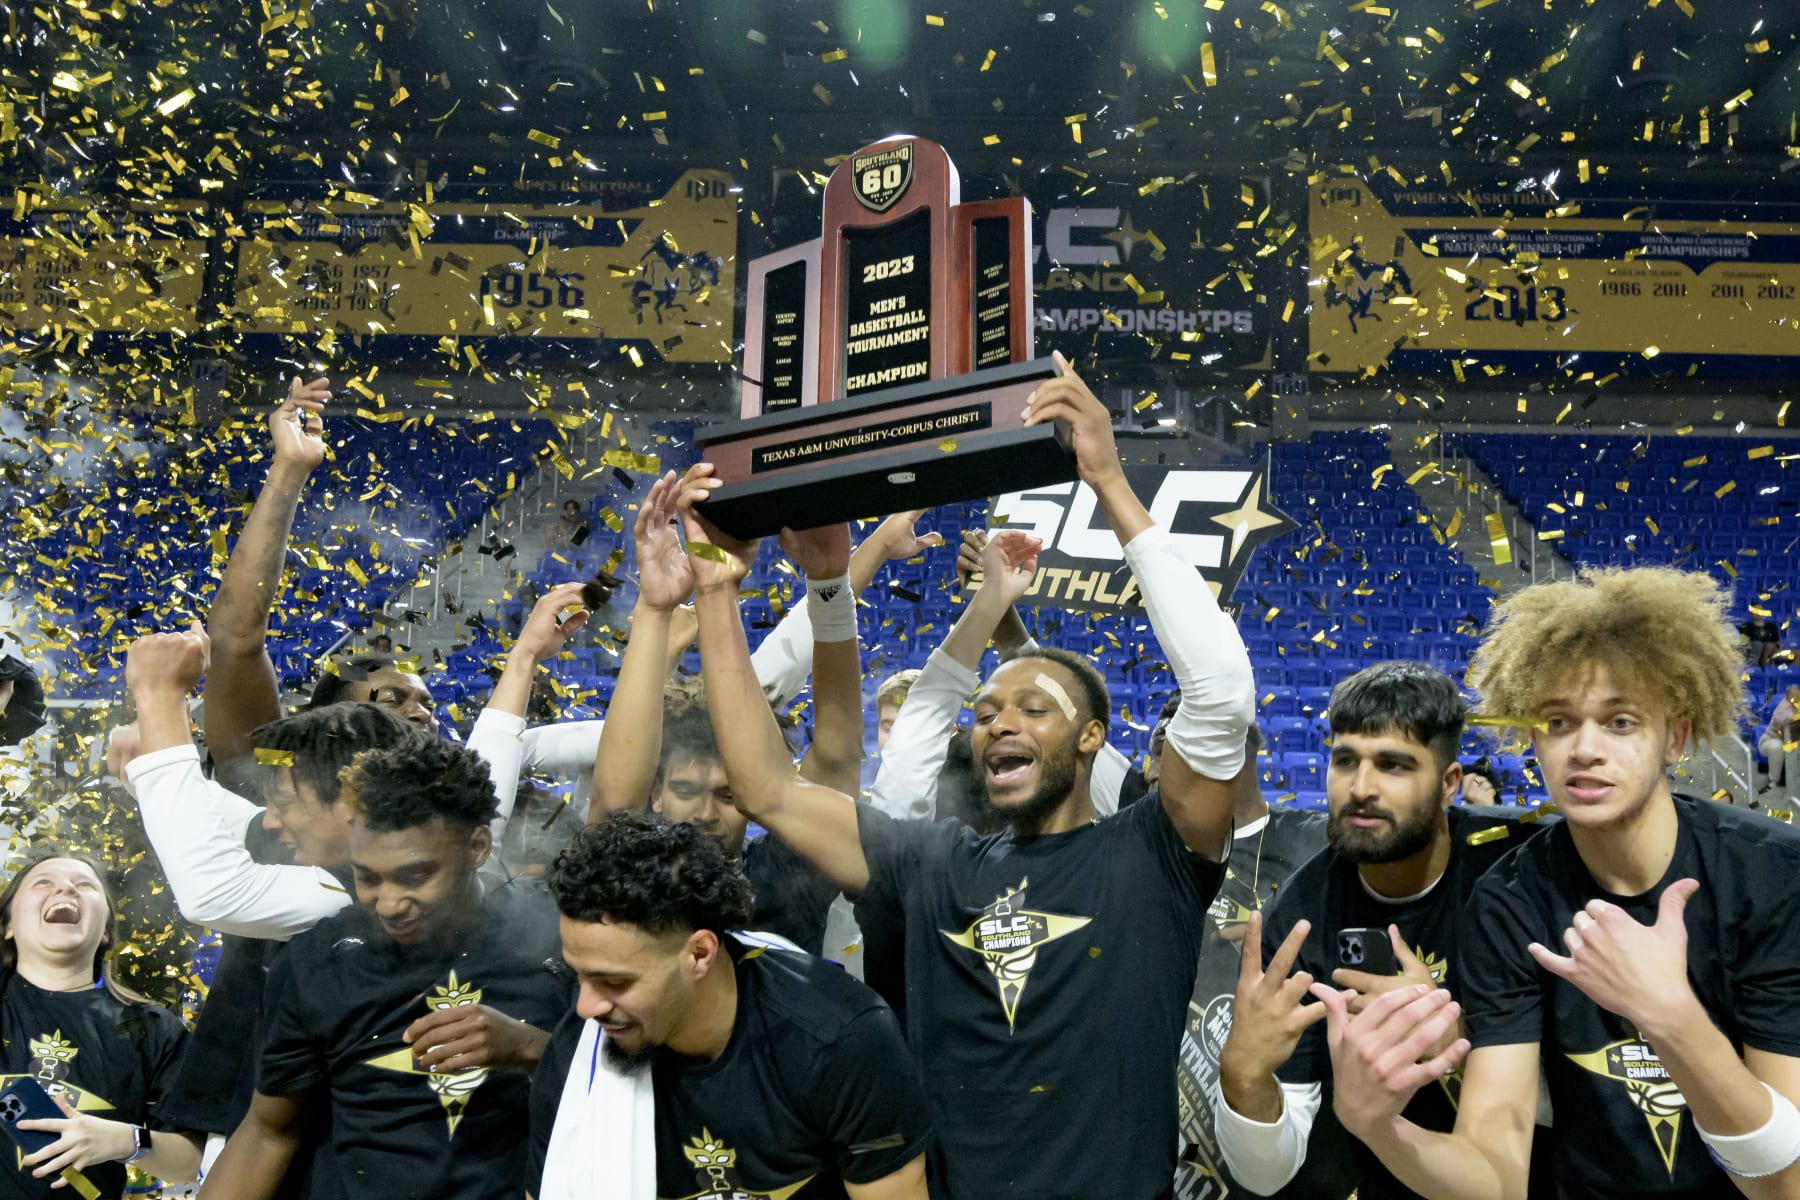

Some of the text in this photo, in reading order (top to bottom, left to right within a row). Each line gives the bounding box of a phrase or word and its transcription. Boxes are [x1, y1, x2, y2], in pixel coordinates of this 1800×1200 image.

[856, 147, 909, 173] SOUTHLAND
[863, 164, 901, 195] 60
[1393, 191, 1459, 205] WOMEN'S
[1640, 236, 1752, 246] SOUTHLAND CONFERENCE
[1646, 245, 1750, 257] CHAMPIONSHIPS
[354, 264, 392, 278] 1957
[863, 255, 915, 284] 2023
[1722, 271, 1778, 279] TOURNAMENT
[480, 272, 585, 308] 1956
[1653, 283, 1687, 297] 2011
[1711, 284, 1795, 299] 2011 2012
[869, 295, 907, 314] MEN'S
[1465, 285, 1567, 322] 2013
[850, 310, 926, 338] BASKETBALL
[1033, 308, 1253, 333] AMPIONSHIPS
[847, 326, 930, 356] TOURNAMENT
[847, 361, 928, 390] CHAMPION
[762, 411, 979, 463] TEXAS A&M UNIVERSITY-CORPUS CHRISTI
[986, 470, 1252, 569] SLC
[979, 916, 1029, 936] SLC
[981, 930, 1031, 942] SOUTHLAND
[983, 935, 1031, 951] CHAMPIONS
[1621, 1045, 1660, 1062] SL
[1626, 1067, 1671, 1079] CHAMPI
